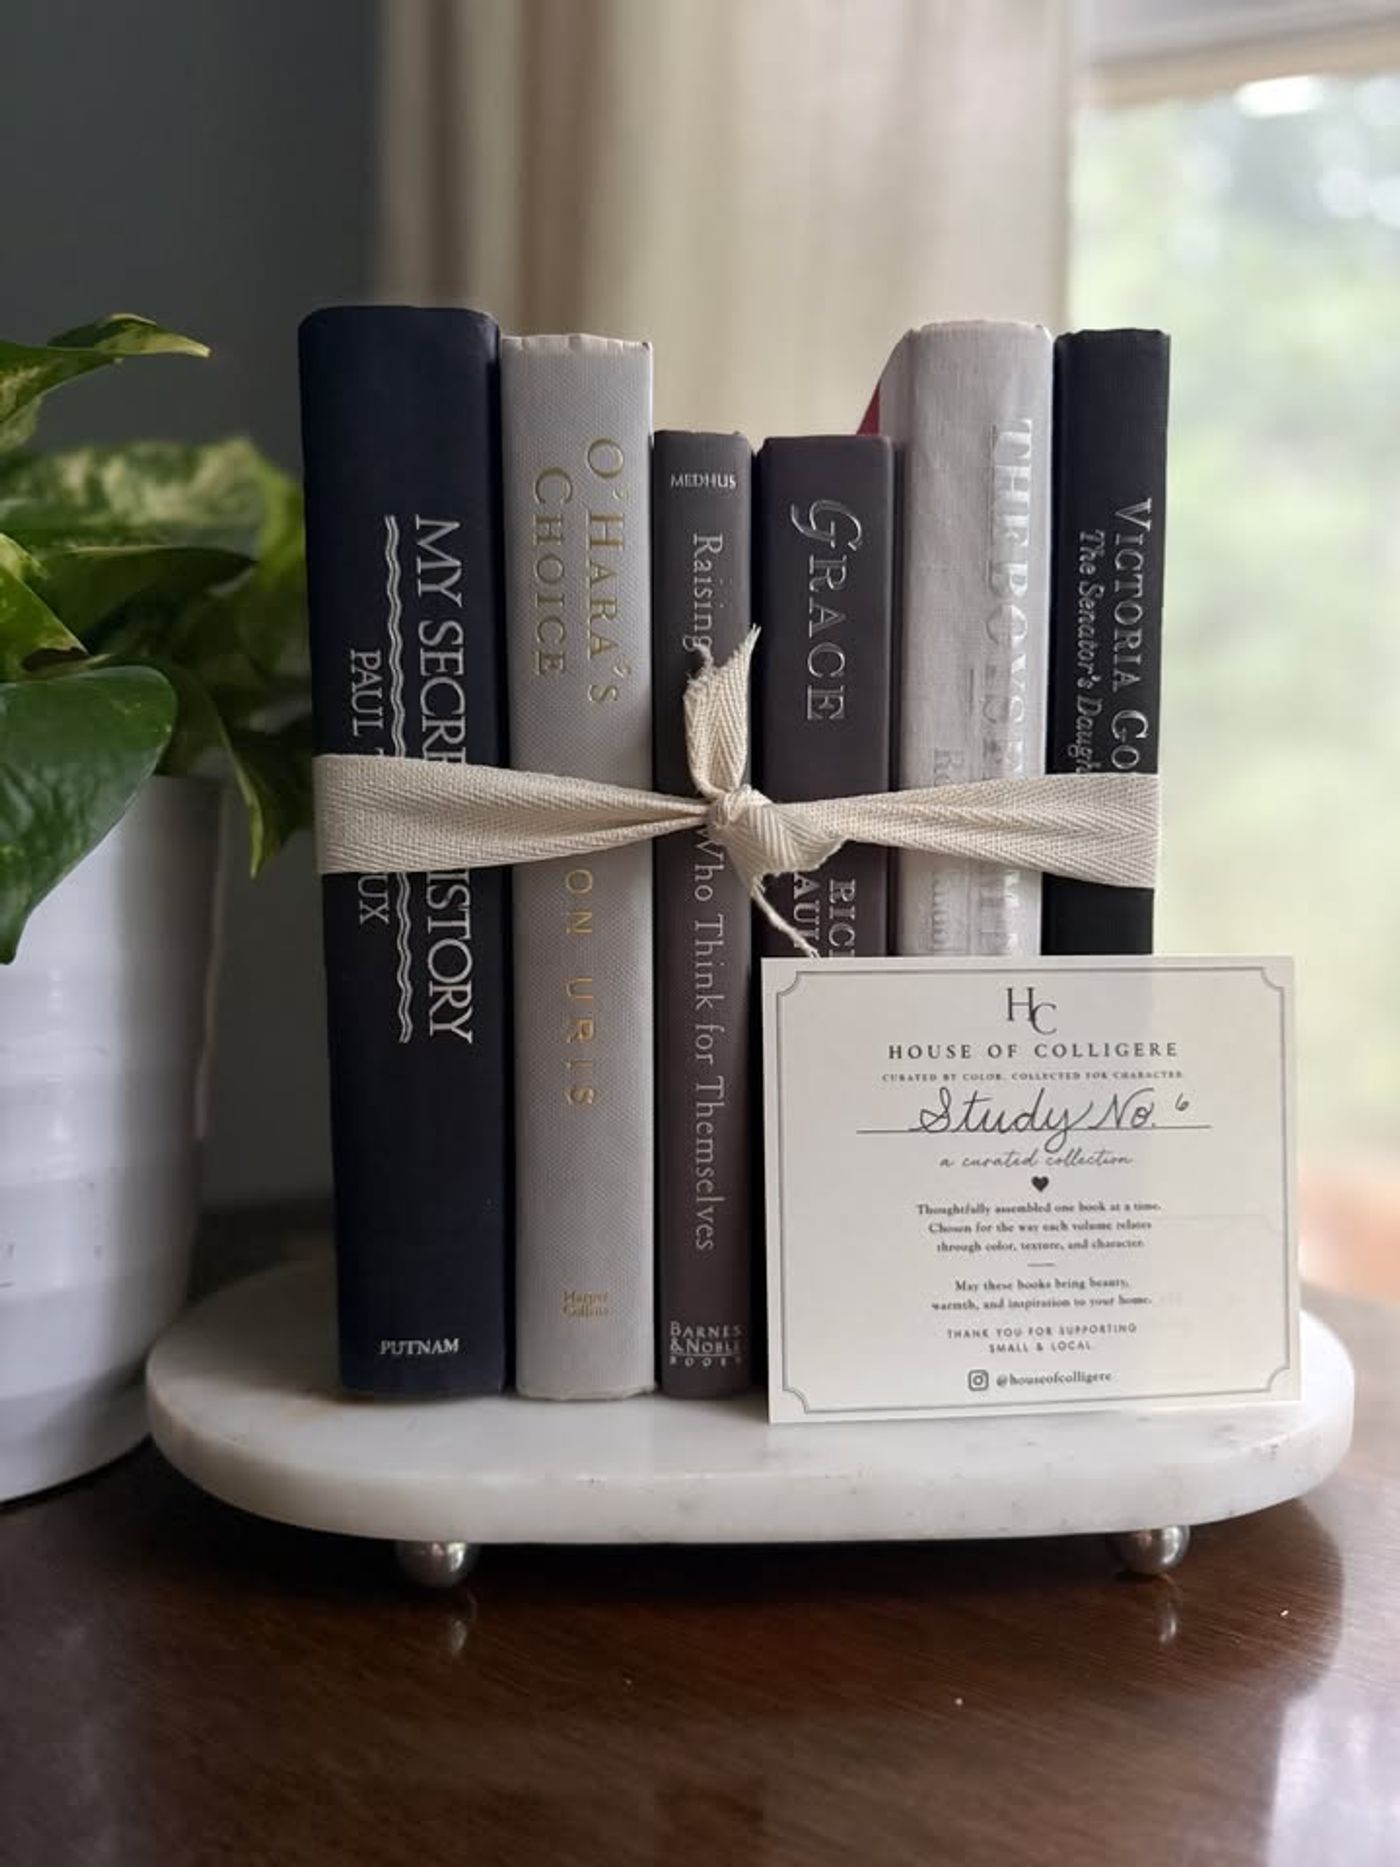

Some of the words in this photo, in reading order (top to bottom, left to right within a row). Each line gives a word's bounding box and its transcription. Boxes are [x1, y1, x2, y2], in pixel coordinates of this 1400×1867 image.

[670, 473, 737, 489] MEDHUS
[415, 514, 463, 607] MY
[533, 466, 573, 677] CHOICE
[586, 437, 631, 703] O'HARA'S
[1079, 530, 1105, 575] The
[683, 533, 724, 652] Raising
[791, 499, 862, 720] GRACE
[1112, 498, 1152, 693] VICTORIA
[1077, 580, 1105, 689] Senator's
[350, 649, 384, 737] PAUL
[418, 620, 466, 763] SECRE
[1068, 695, 1103, 774] Daugh
[793, 872, 821, 949] AUL
[426, 869, 475, 1043] ISTORY
[694, 914, 725, 1010] Think
[1006, 987, 1057, 1035] HC
[565, 977, 595, 1104] URIS
[694, 1023, 725, 1065] for
[889, 1044, 972, 1059] HOUSE
[987, 1044, 1018, 1058] OF
[1034, 1042, 1178, 1058] COLLIGERE
[882, 1073, 937, 1082] CURATED
[943, 1073, 956, 1082] BY
[1011, 1071, 1081, 1081] COLLECTED
[1086, 1071, 1108, 1080] FOR
[909, 1086, 1094, 1154] Study
[1174, 1092, 1190, 1112] 6
[695, 1075, 725, 1250] Themselves
[939, 1157, 953, 1168] a
[962, 1149, 1039, 1168] curated
[1045, 1148, 1133, 1168] collection
[916, 1203, 990, 1217] Thoughtfully
[994, 1203, 1051, 1214] assembled
[1054, 1205, 1075, 1213] one
[1078, 1202, 1106, 1212] book
[1109, 1203, 1123, 1211] at
[928, 1222, 972, 1234] Chosen
[975, 1222, 992, 1233] for
[995, 1222, 1014, 1232] the
[1017, 1224, 1039, 1234] way
[1042, 1221, 1069, 1232] each
[1071, 1220, 1113, 1231] volume
[1116, 1219, 1152, 1230] relates
[936, 1241, 982, 1254] through
[985, 1240, 1016, 1252] color,
[1020, 1240, 1064, 1251] texture,
[1067, 1239, 1088, 1250] and
[931, 1300, 979, 1312] warmth,
[983, 1299, 1004, 1310] and
[1007, 1297, 1071, 1311] inspiration
[1073, 1299, 1086, 1308] to
[1088, 1297, 1115, 1308] your
[954, 1280, 979, 1293] May
[983, 1279, 1013, 1291] these
[1017, 1278, 1051, 1290] books
[380, 1338, 459, 1355] PUTNAM
[669, 1321, 742, 1338] BARNES
[947, 1328, 989, 1339] THANK
[996, 1327, 1022, 1337] YOU
[1028, 1326, 1052, 1336] FOR
[1059, 1323, 1137, 1336] SUPPORTING
[989, 1343, 1029, 1354] SMALL
[1036, 1342, 1044, 1352] &
[1051, 1340, 1091, 1351] LOCAL
[996, 1369, 1112, 1387] @houseofcolligere
